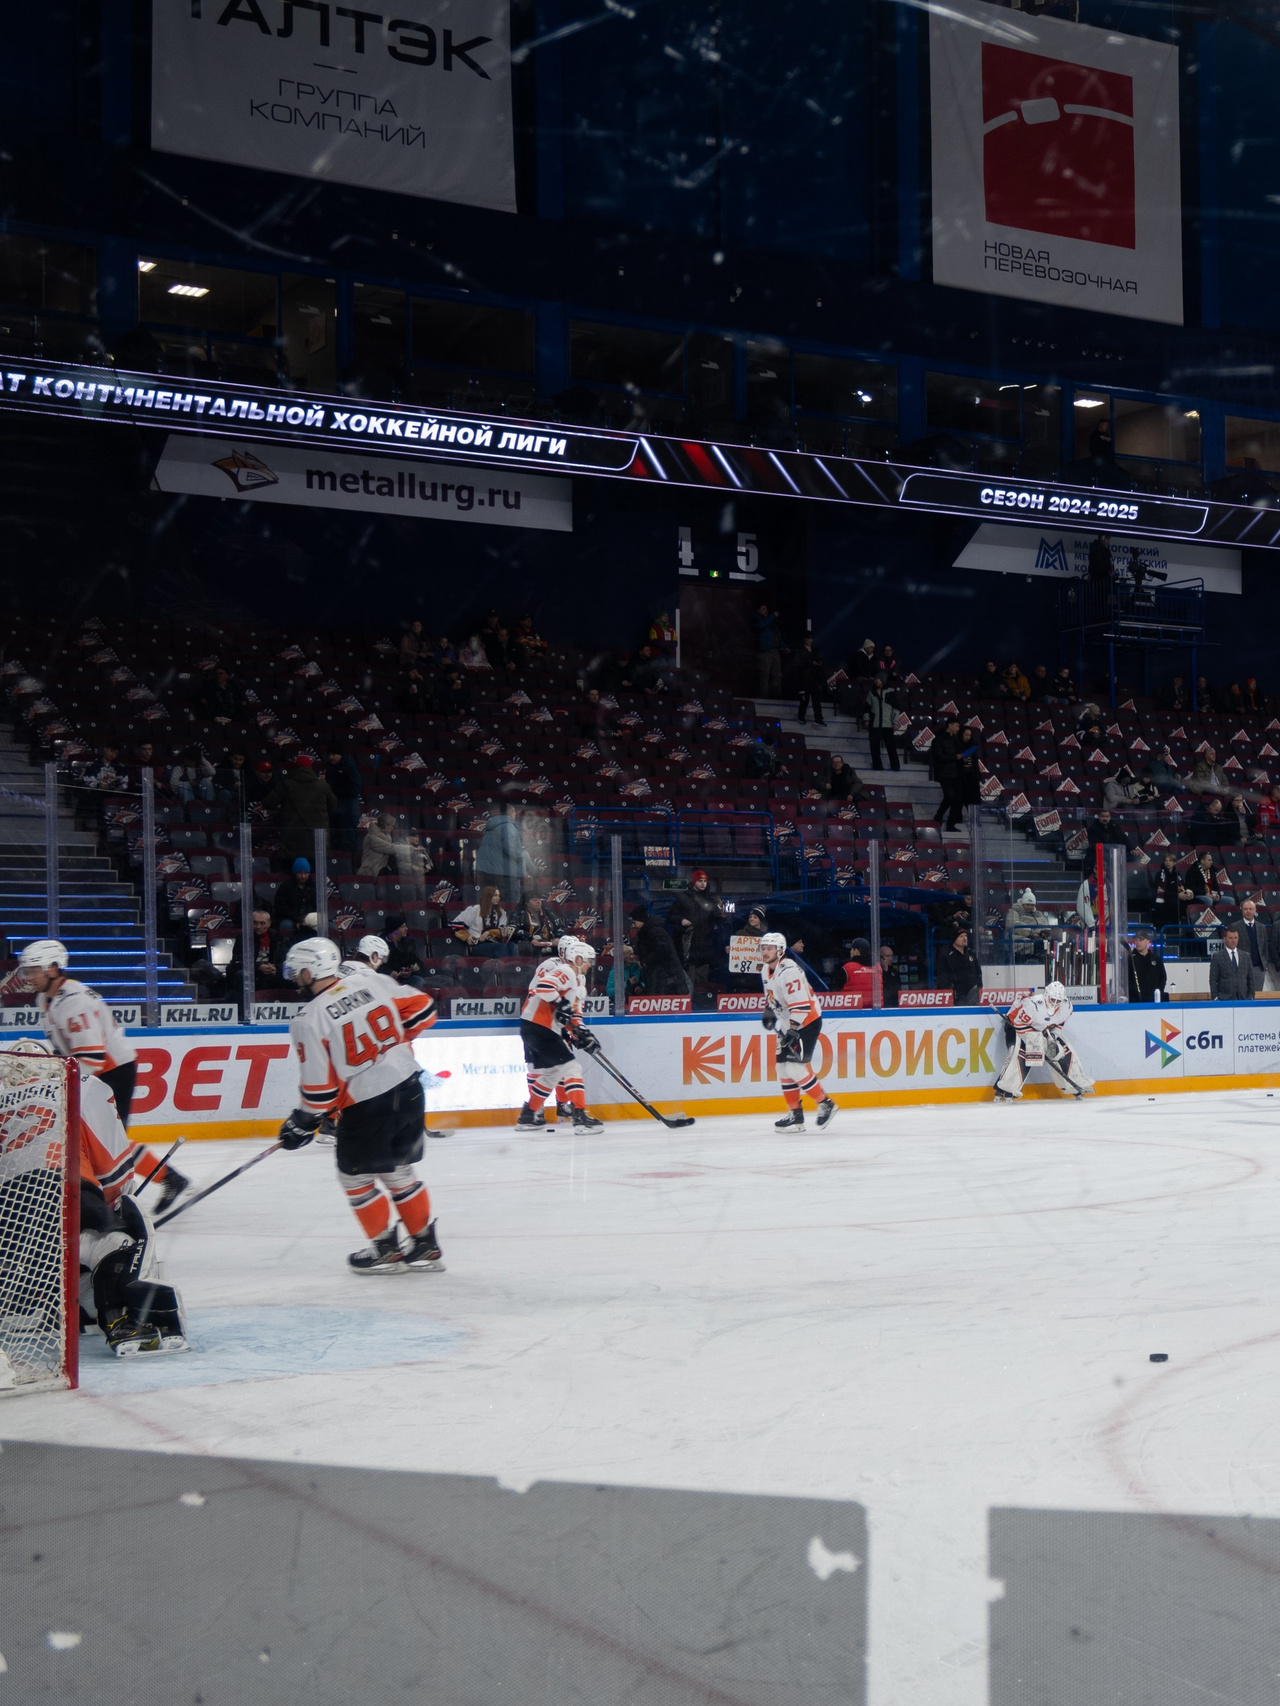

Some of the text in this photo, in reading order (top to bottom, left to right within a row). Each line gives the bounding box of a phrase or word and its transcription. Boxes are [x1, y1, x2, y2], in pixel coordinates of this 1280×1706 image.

[191, 0, 493, 80] АЛТЭК
[279, 79, 398, 118] ГРУППА
[250, 99, 426, 148] КОМПАНИЙ
[985, 240, 1050, 264] НОВАЯ
[985, 256, 1138, 294] ПЕРЕВОЗОЧНАЯ
[33, 376, 325, 428] КОНТИНЕНТАЛЬНОЙ
[330, 413, 494, 448] ХОККЕЙНОЙ
[497, 427, 568, 456] ЛИГИ
[305, 466, 521, 512] metallurg.ru
[980, 488, 1139, 521] СЕЗОН 2024-2025
[678, 526, 694, 567] 4
[736, 532, 759, 573] 5
[737, 936, 761, 945] АРТУ
[718, 996, 768, 1010] FONBE
[785, 978, 801, 995] 27
[819, 994, 862, 1007] ONBET
[897, 991, 952, 1006] FONBET
[166, 1007, 234, 1023] KHL.RU
[325, 987, 376, 1020] GURKIN
[455, 1002, 517, 1016] KHL.RU
[629, 997, 691, 1012] FONBET
[341, 1005, 400, 1067] 49
[1238, 1032, 1276, 1041] система
[682, 1028, 995, 1085] КИОПОИСК
